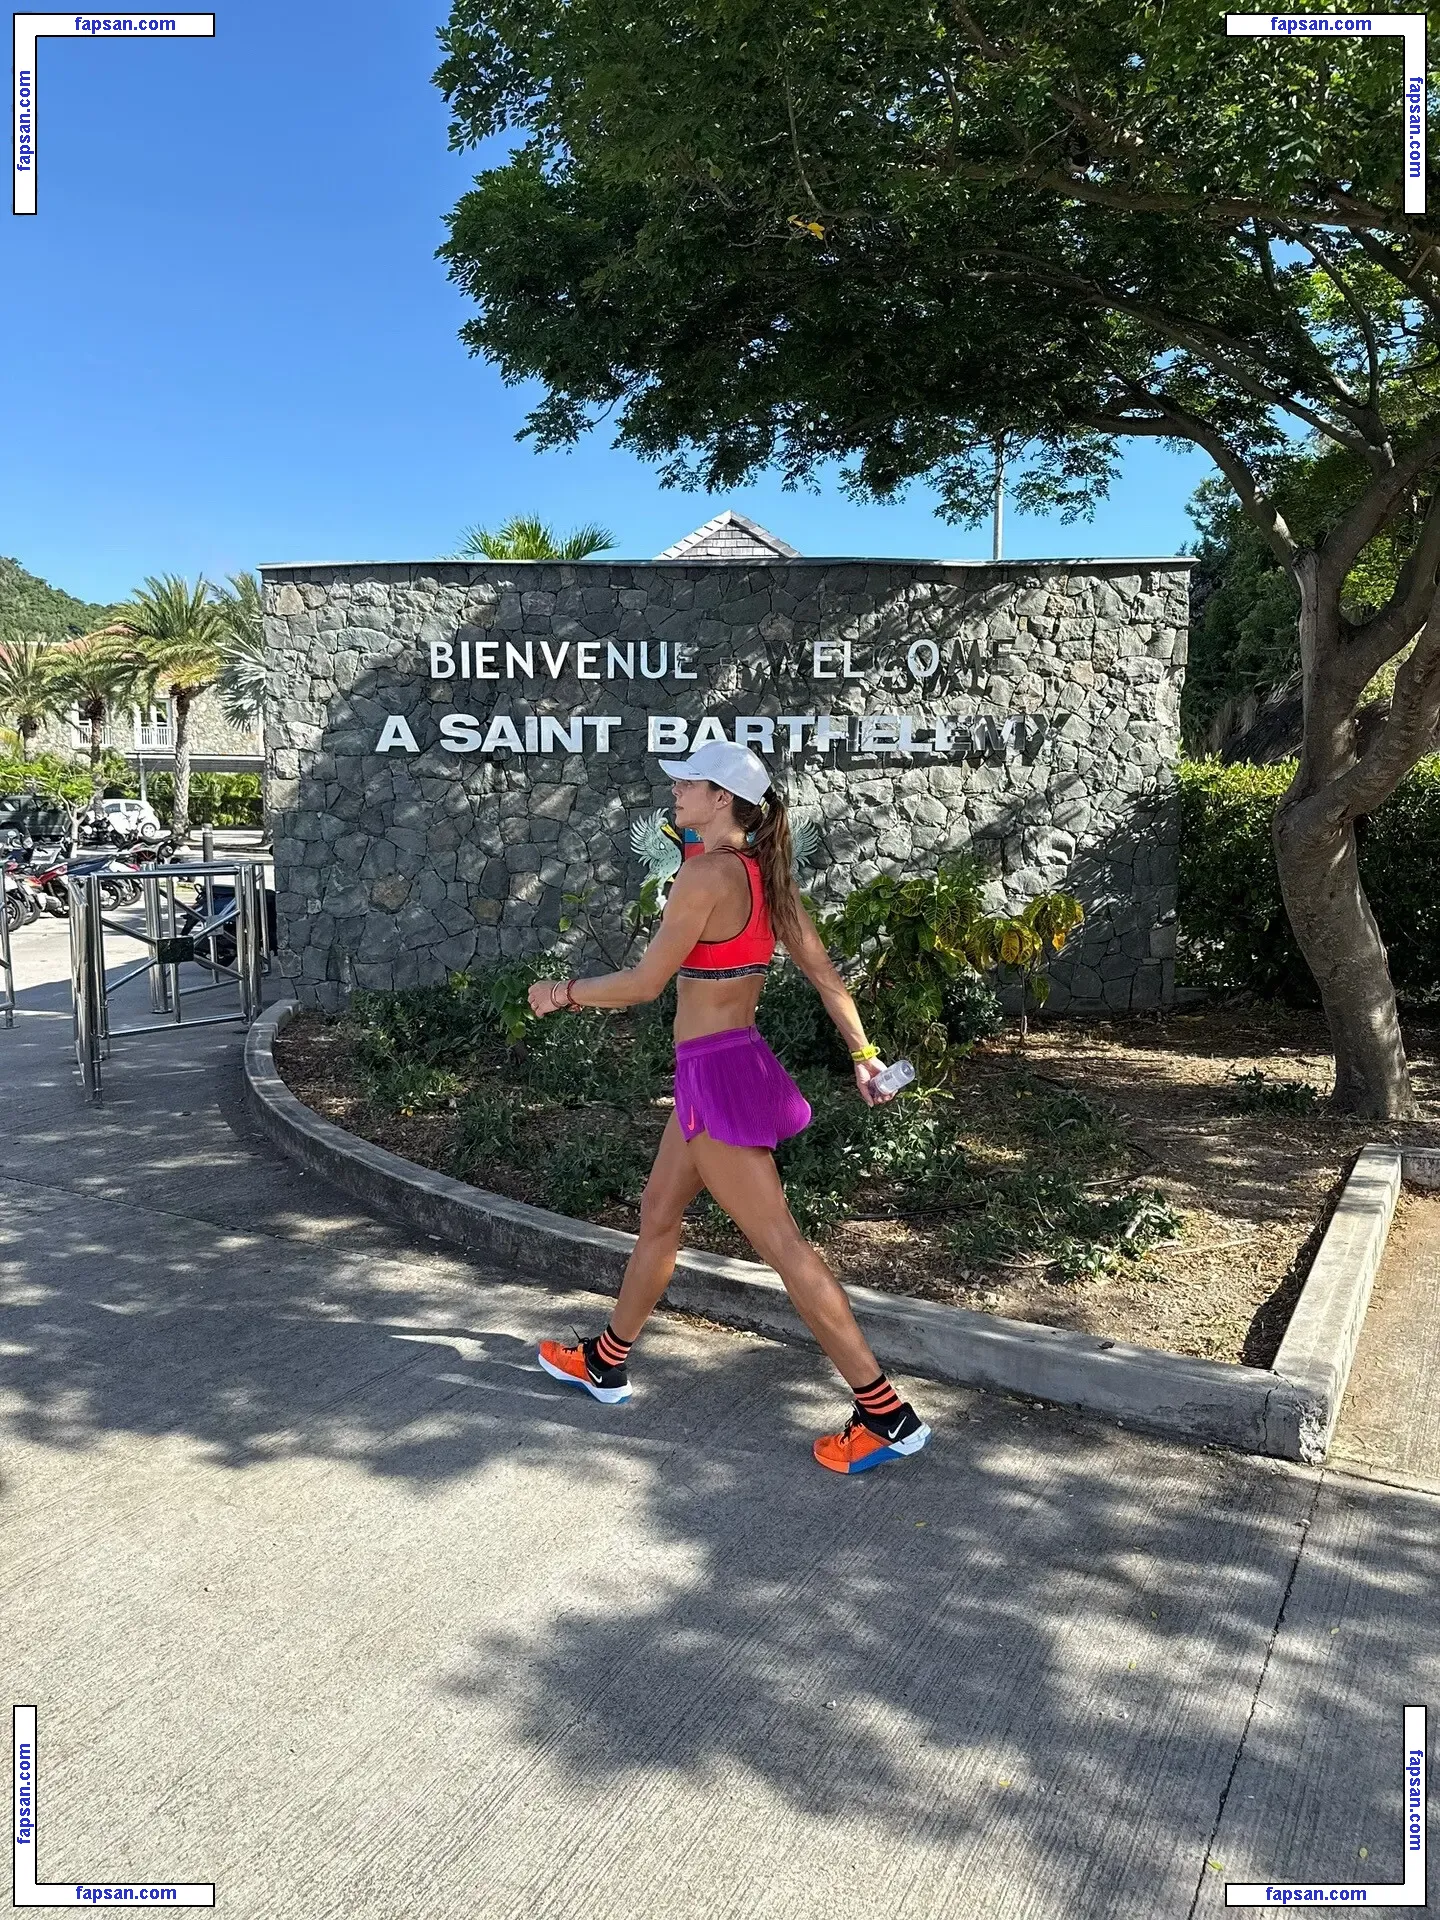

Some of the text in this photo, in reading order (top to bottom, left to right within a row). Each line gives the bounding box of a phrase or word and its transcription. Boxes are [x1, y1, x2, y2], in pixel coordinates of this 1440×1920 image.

[429, 640, 698, 680] BIENVENUE
[374, 713, 1072, 754] A SAINT BARTHELEMY
